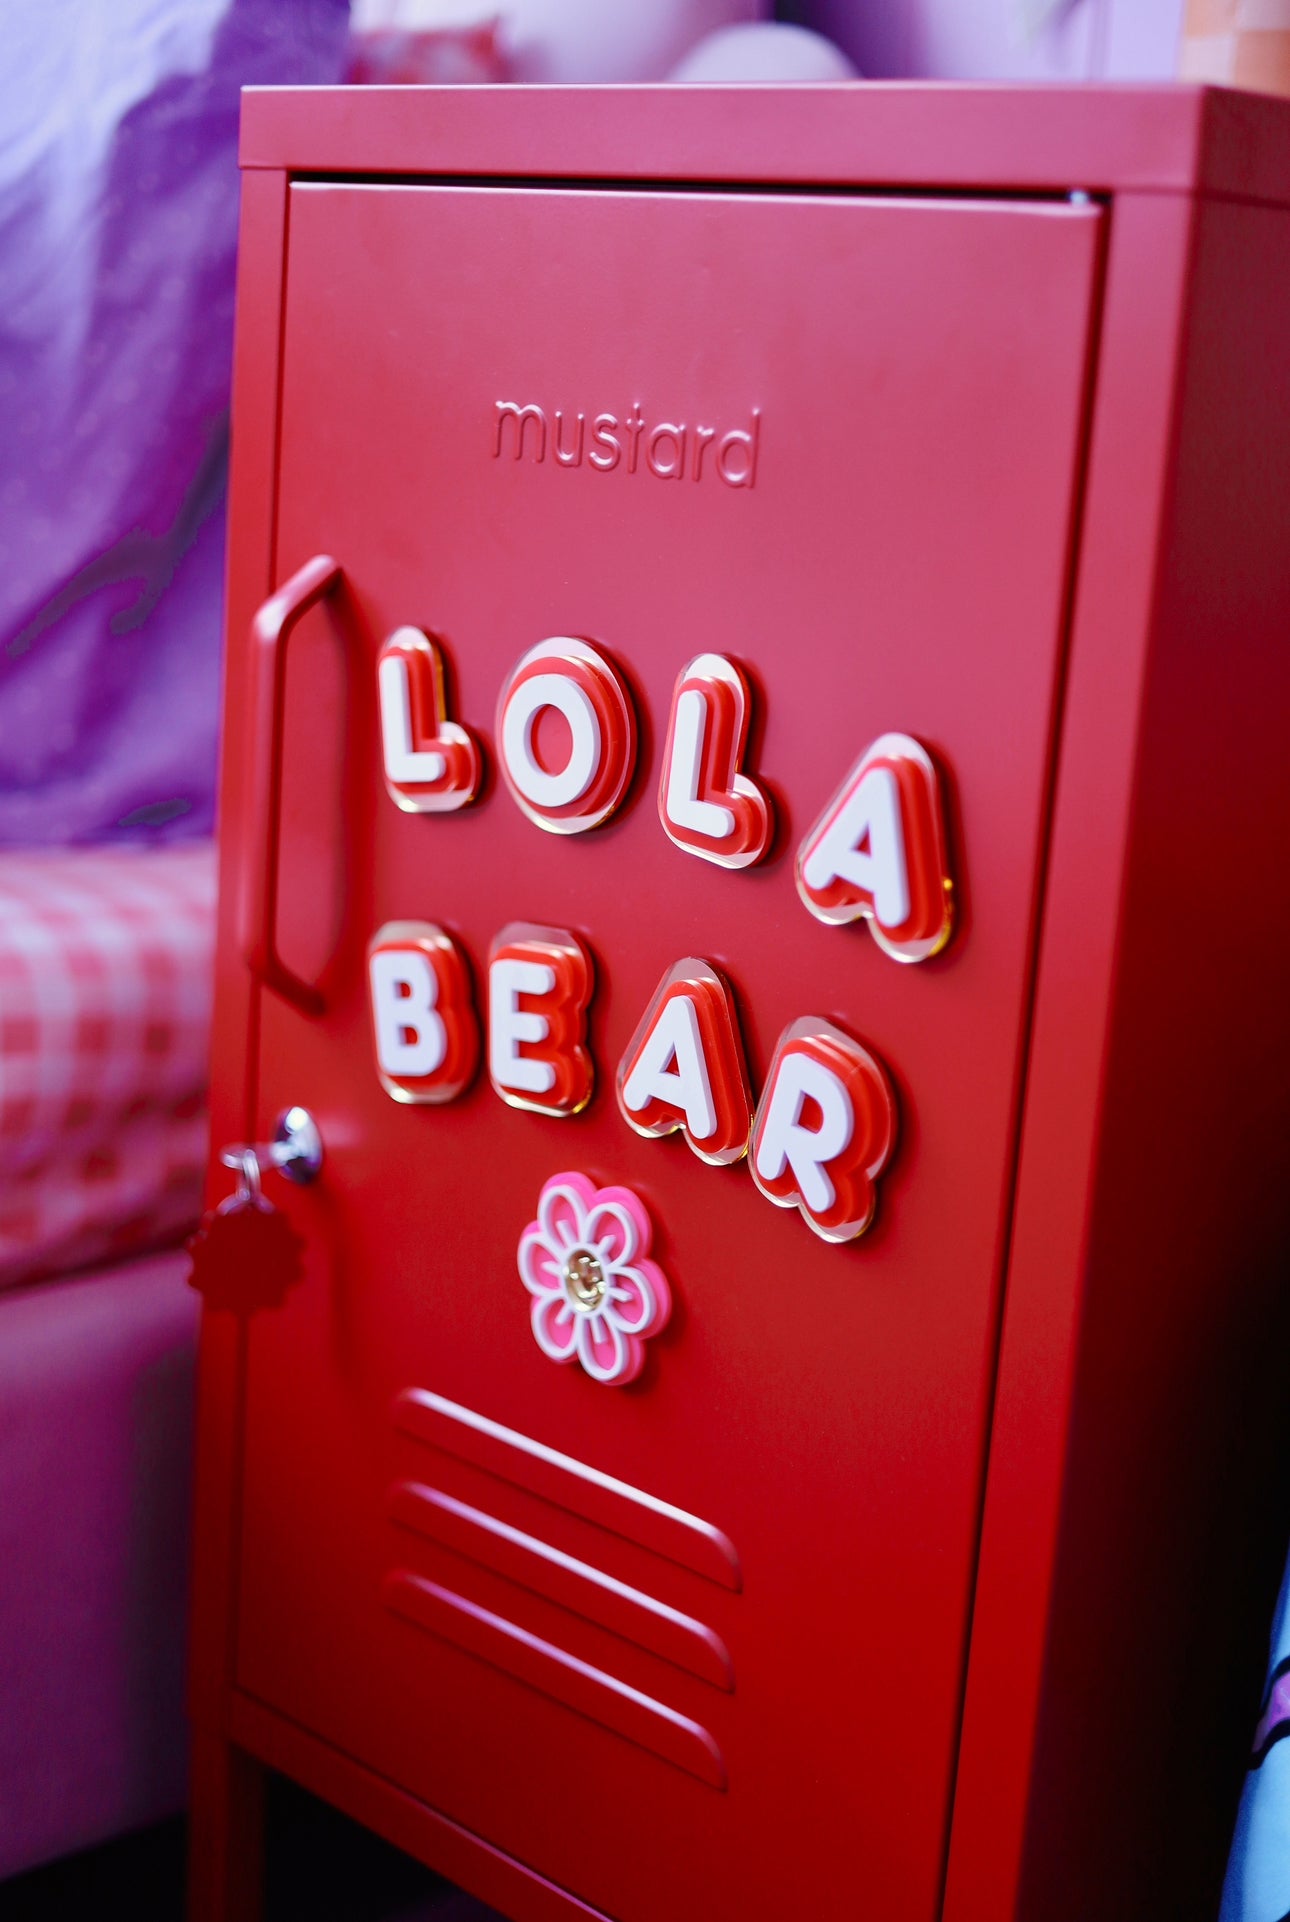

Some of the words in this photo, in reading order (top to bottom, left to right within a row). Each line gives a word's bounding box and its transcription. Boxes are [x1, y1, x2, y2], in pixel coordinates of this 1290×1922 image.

[492, 400, 761, 489] mustard
[378, 645, 944, 942] LOLA
[369, 942, 886, 1227] BEAR
